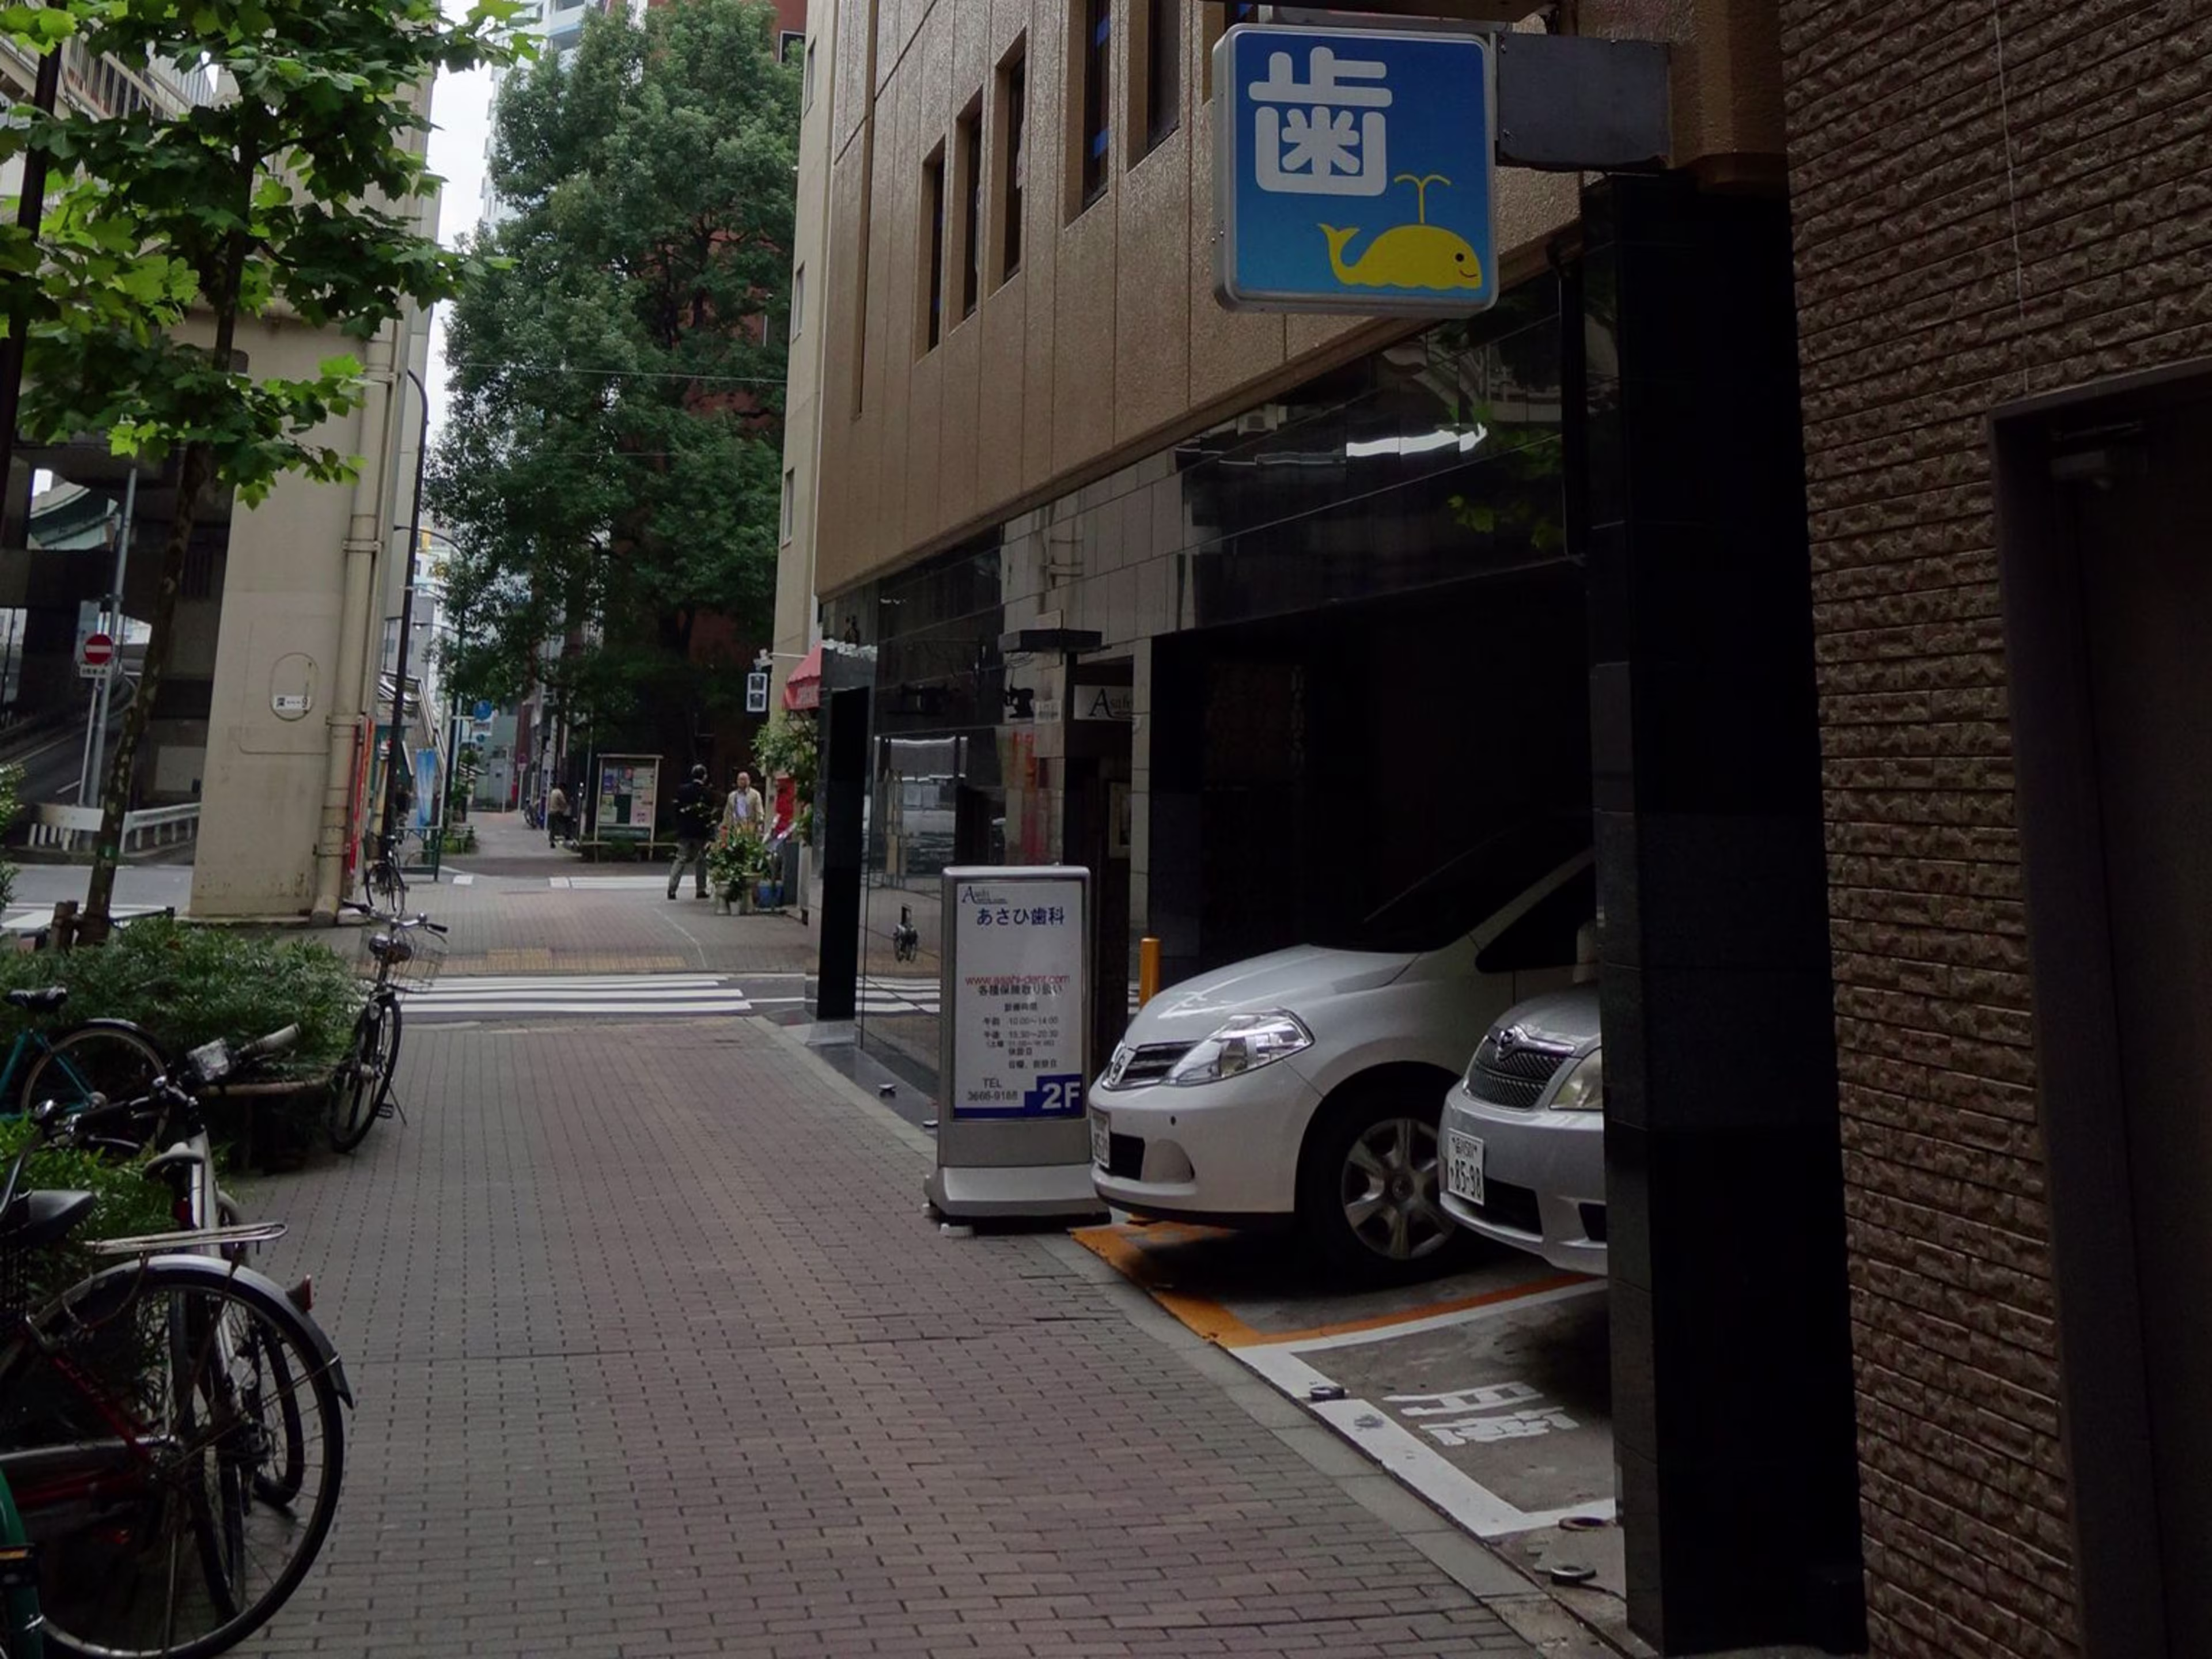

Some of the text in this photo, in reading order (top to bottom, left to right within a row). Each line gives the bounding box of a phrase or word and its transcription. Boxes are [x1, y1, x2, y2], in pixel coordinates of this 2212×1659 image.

[1248, 46, 1393, 197] 歯
[976, 907, 1065, 925] あさひ歯科
[983, 1078, 1002, 1088] TEL
[1041, 1082, 1081, 1110] 2F
